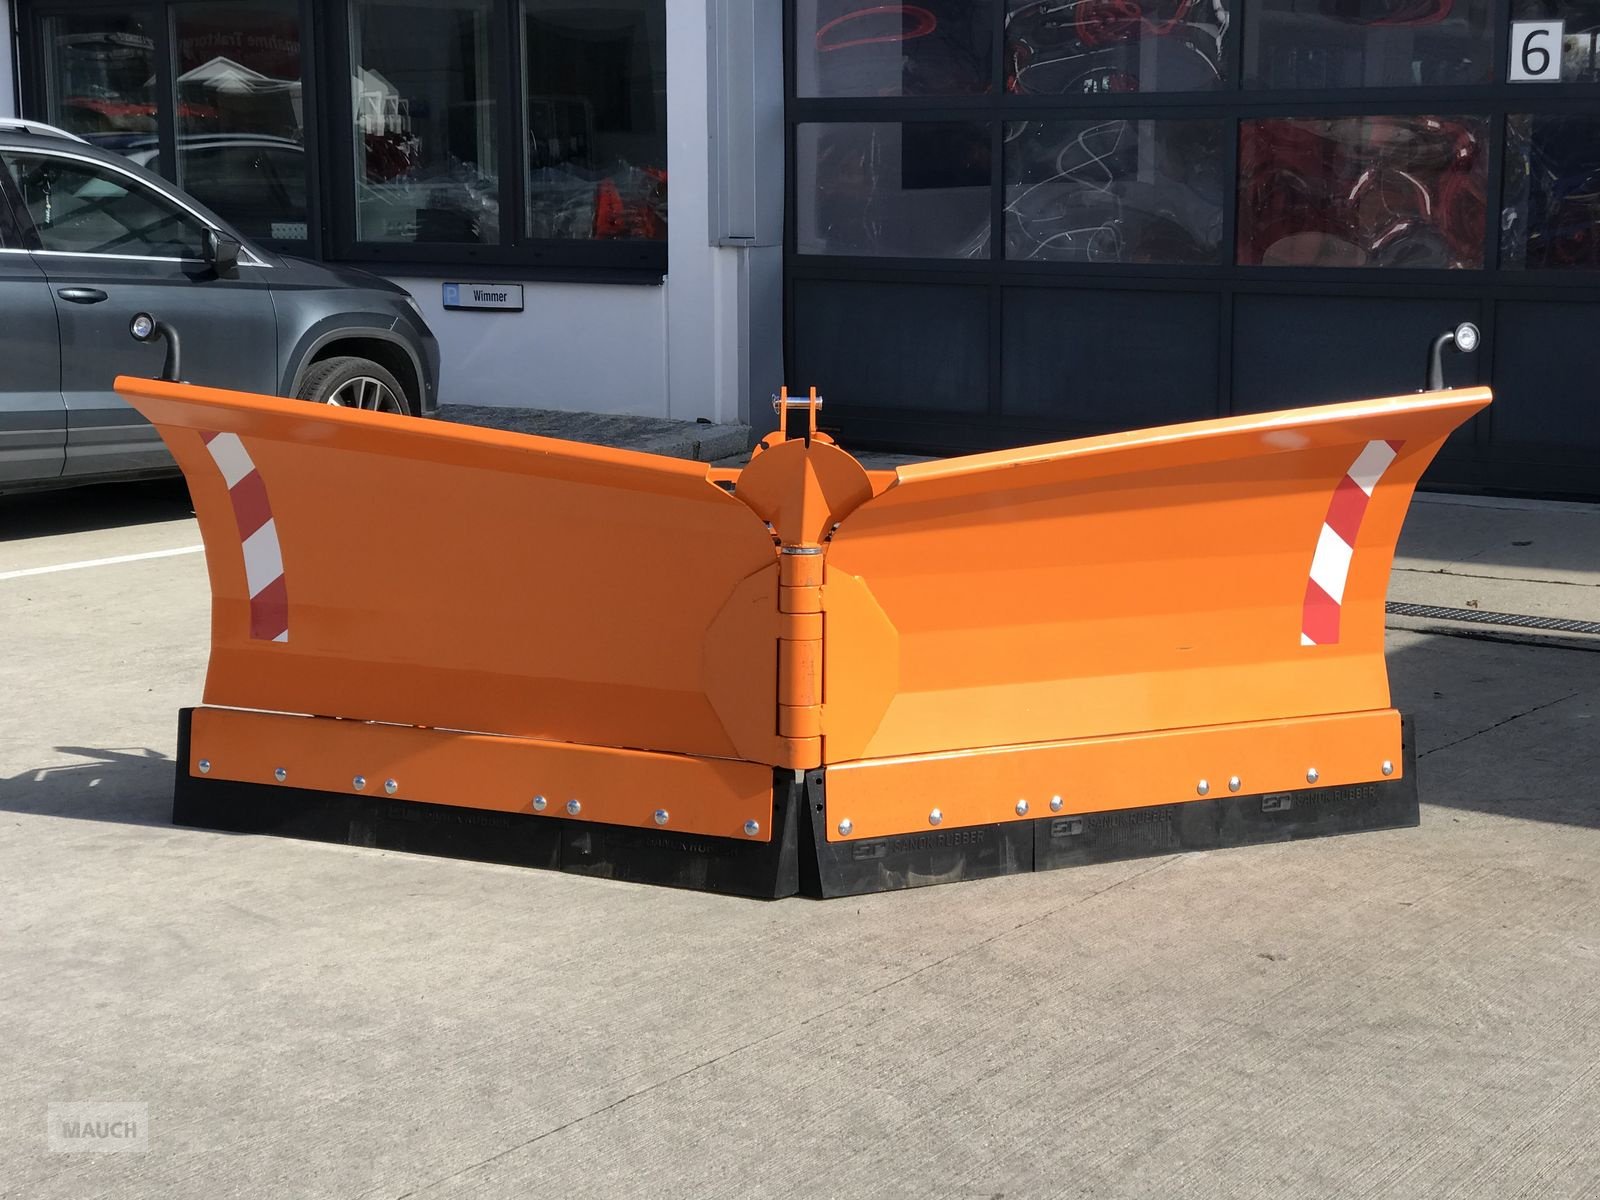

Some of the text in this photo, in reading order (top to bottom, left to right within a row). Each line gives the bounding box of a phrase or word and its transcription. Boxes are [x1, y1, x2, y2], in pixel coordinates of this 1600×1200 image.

[1521, 29, 1550, 76] 6
[446, 286, 507, 303] P Wimmer
[1334, 785, 1377, 802] RUBBER
[893, 836, 934, 853] SANOK
[936, 830, 986, 848] RUBBER
